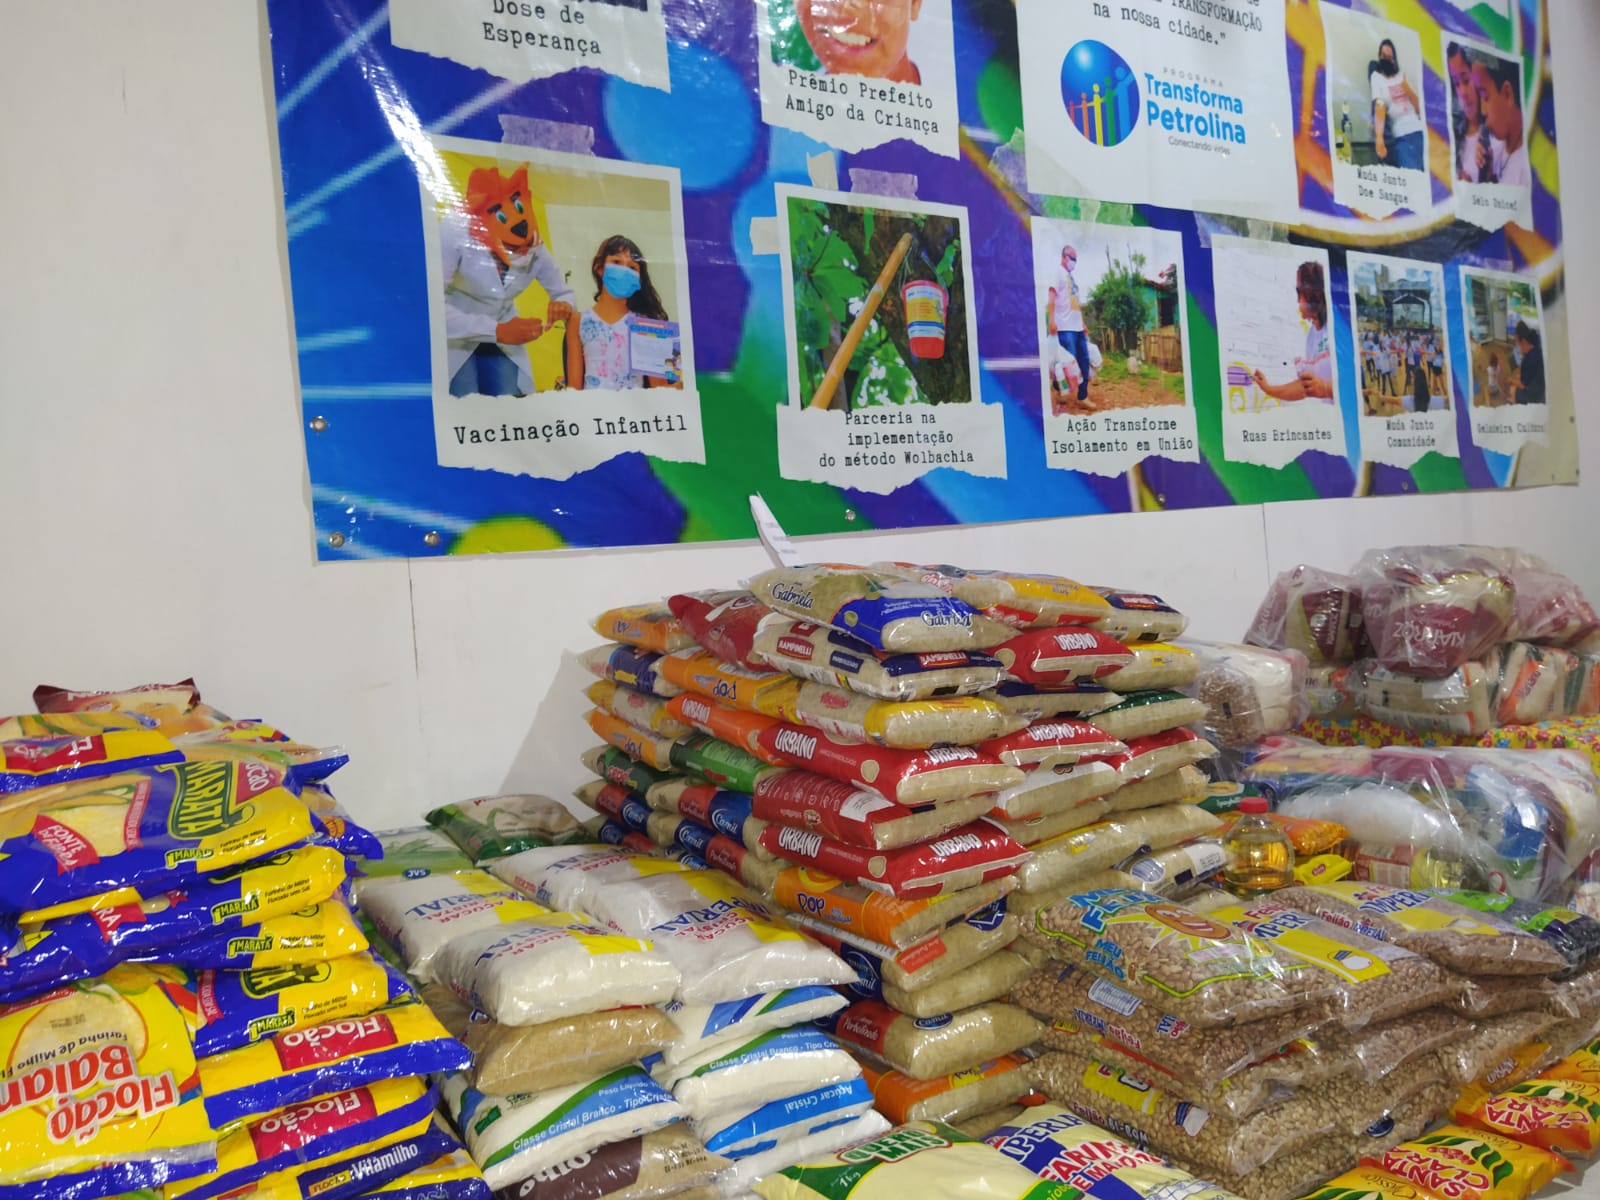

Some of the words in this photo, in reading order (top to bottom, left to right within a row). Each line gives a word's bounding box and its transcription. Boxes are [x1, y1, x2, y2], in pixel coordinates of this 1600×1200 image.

[494, 0, 546, 19] Dose
[560, 5, 584, 24] de
[1093, 2, 1111, 18] na
[1121, 7, 1161, 30] nossa
[1168, 19, 1226, 45] cidade."
[482, 22, 601, 56] Esperança
[788, 69, 848, 95] Prêmio
[859, 82, 933, 110] Prefeito
[1144, 72, 1243, 115] Transforma
[785, 94, 835, 121] Amigo
[846, 104, 865, 121] da
[874, 109, 939, 135] Criança
[1146, 100, 1247, 145] Petrolina
[1358, 184, 1376, 198] Doe
[1378, 187, 1409, 206] Sangue
[453, 419, 581, 445] Vacinação
[593, 414, 688, 436] Infantil
[845, 411, 913, 426] Parceria
[921, 413, 937, 425] na
[1067, 418, 1097, 435] Ação
[1104, 417, 1178, 432] Transforme
[848, 430, 954, 449] implementação
[1052, 438, 1129, 455] Isolamento
[1136, 440, 1151, 452] em
[1158, 436, 1194, 451] União
[1242, 429, 1268, 442] Ruas
[1272, 427, 1333, 441] Brincantes
[1386, 435, 1436, 448] Comunidade
[819, 453, 836, 467] do
[844, 451, 896, 467] método
[904, 450, 975, 465] Wolbachia
[1053, 633, 1098, 651] URBANO
[682, 697, 711, 724] URBANO
[775, 727, 818, 761] URBANO
[1026, 723, 1076, 742] URBANO
[47, 824, 88, 853] FONTE
[778, 826, 823, 859] URBANO
[929, 833, 983, 857] URBANO
[78, 1030, 128, 1046] Farinha
[283, 1016, 382, 1047] Flocão
[16, 1050, 56, 1070] Milho
[59, 1041, 76, 1055] de
[709, 1056, 740, 1069] Classe
[740, 1047, 769, 1064] Cristal
[769, 1045, 799, 1057] Branco
[805, 1041, 823, 1051] Tipo
[0, 1045, 134, 1111] Baian
[51, 1075, 174, 1140] Flocão
[260, 1091, 362, 1132] Flocão
[784, 1095, 819, 1114] Cristal
[513, 1128, 547, 1151] Classe
[548, 1114, 580, 1135] Cristal
[581, 1104, 616, 1123] Branco
[844, 1129, 927, 1161] QUERO
[877, 1134, 946, 1160] MAIS
[352, 1142, 419, 1181] Vitamilho
